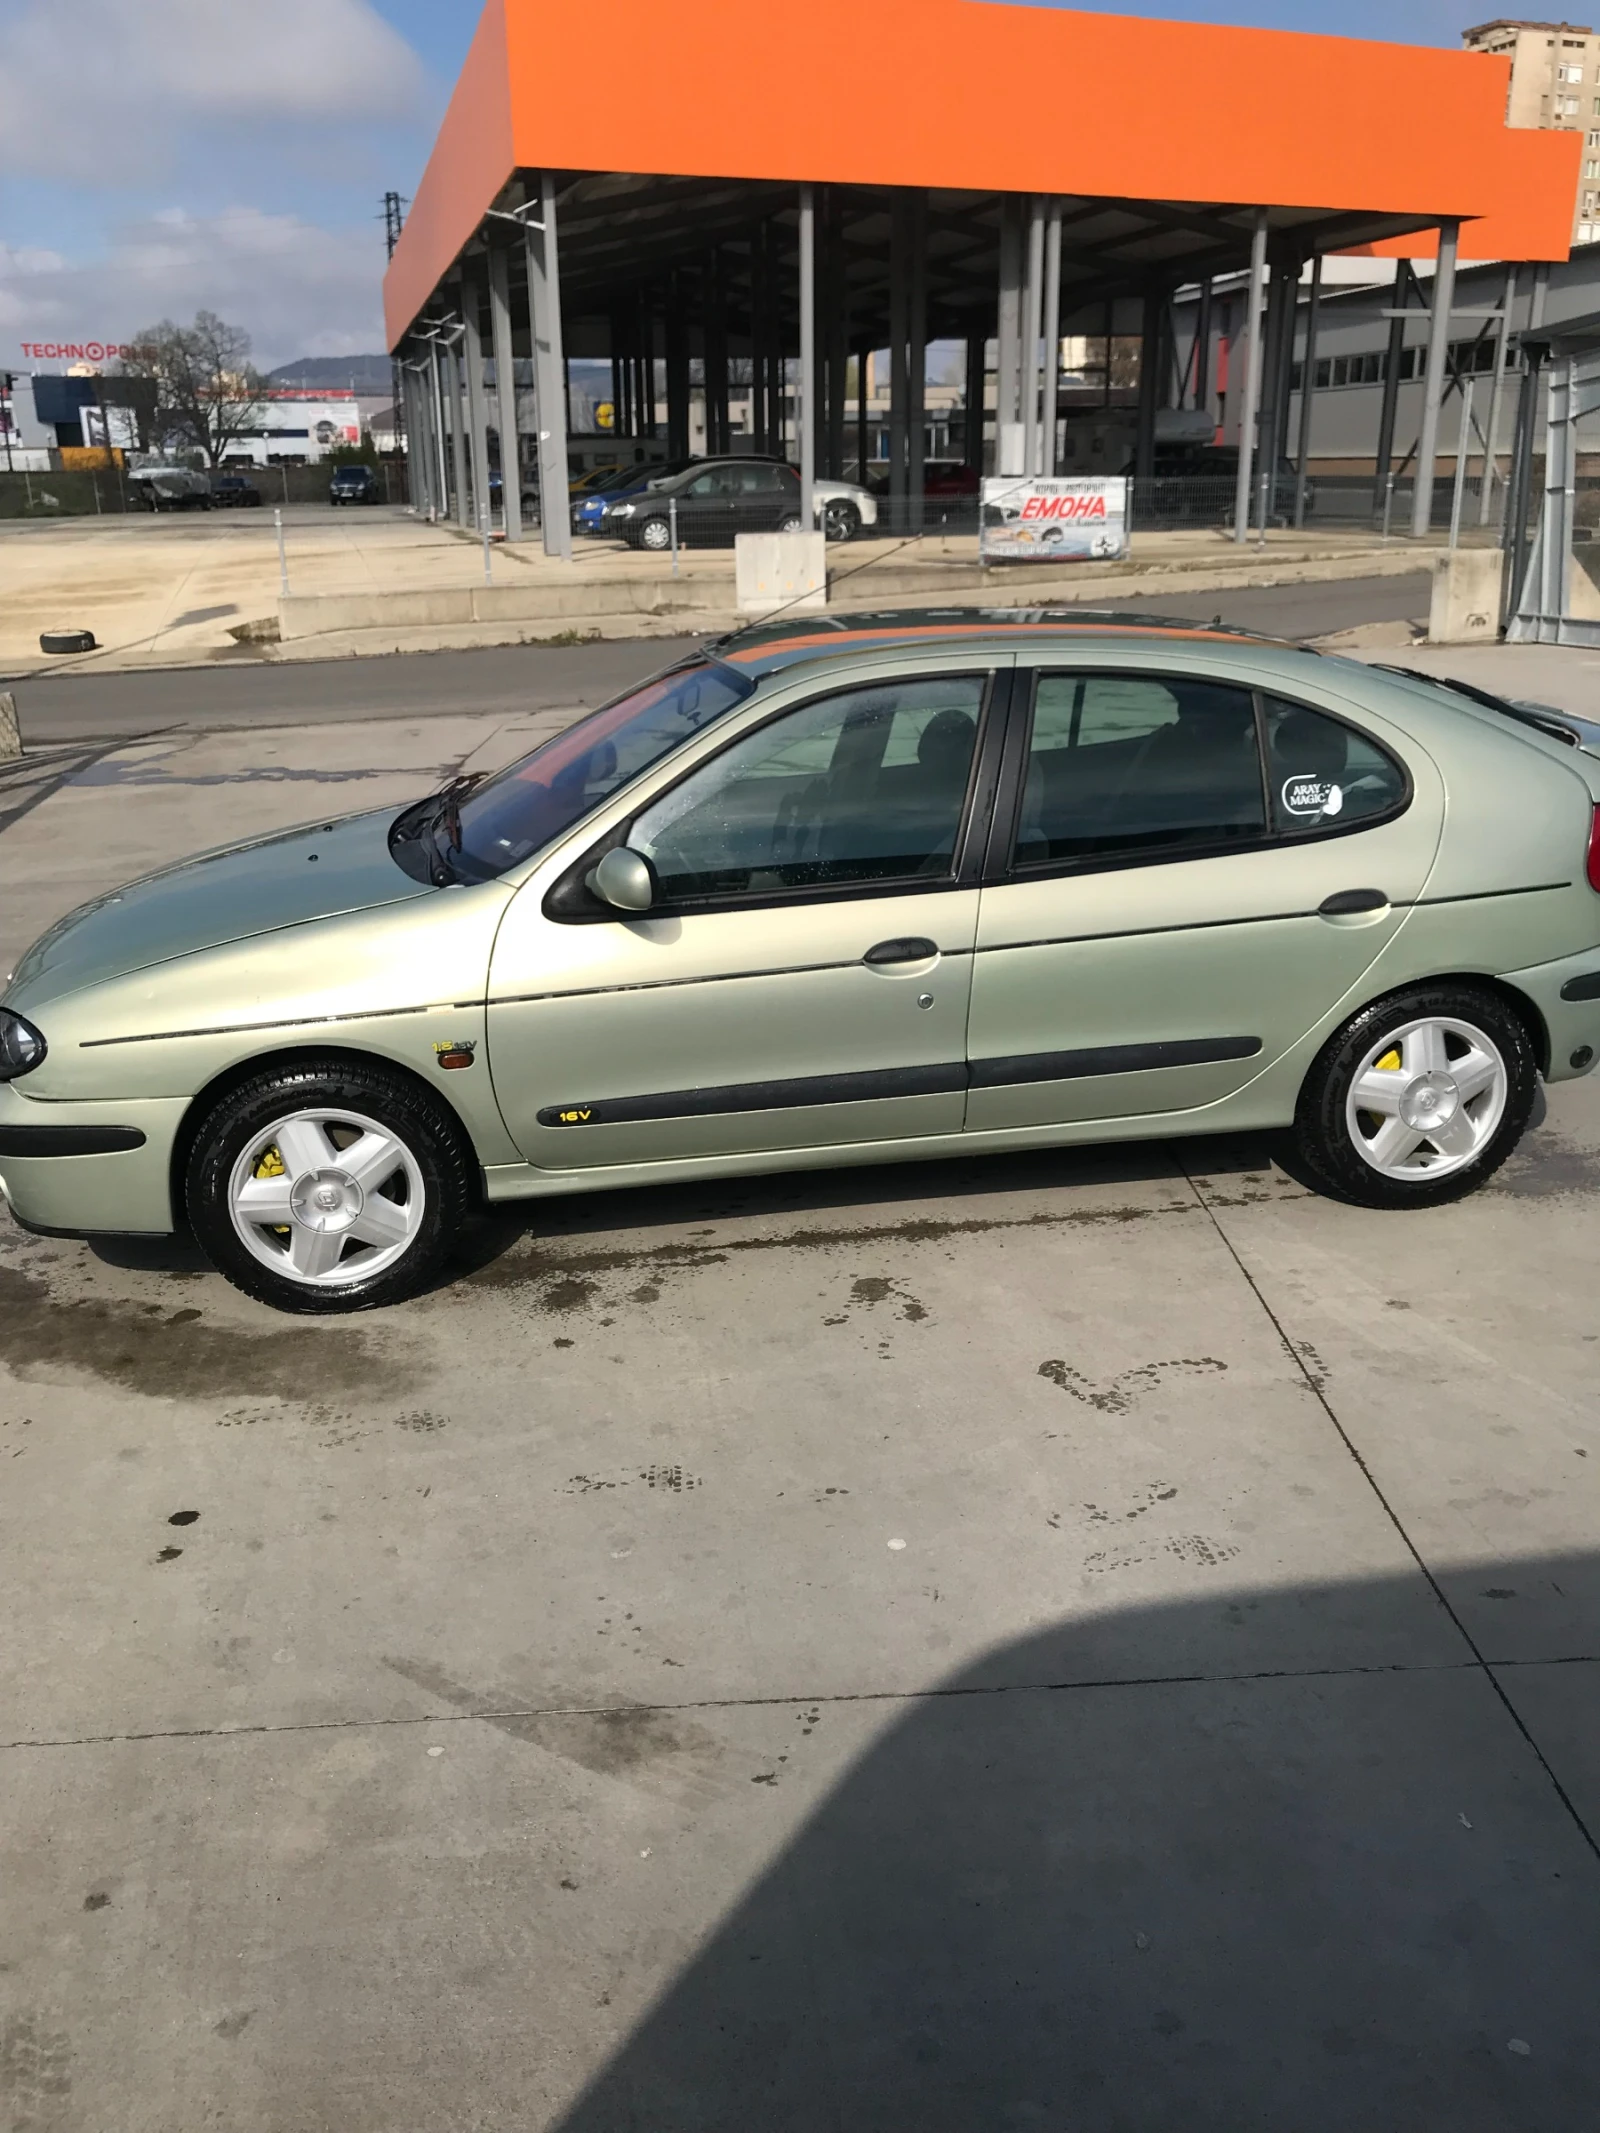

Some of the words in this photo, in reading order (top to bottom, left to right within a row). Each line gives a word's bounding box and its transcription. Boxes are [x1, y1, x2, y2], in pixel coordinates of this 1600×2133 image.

[21, 342, 157, 361] TECHNOPO
[1293, 783, 1322, 796] ARAY
[1290, 793, 1326, 806] MAGIC
[559, 1109, 592, 1122] 16V
